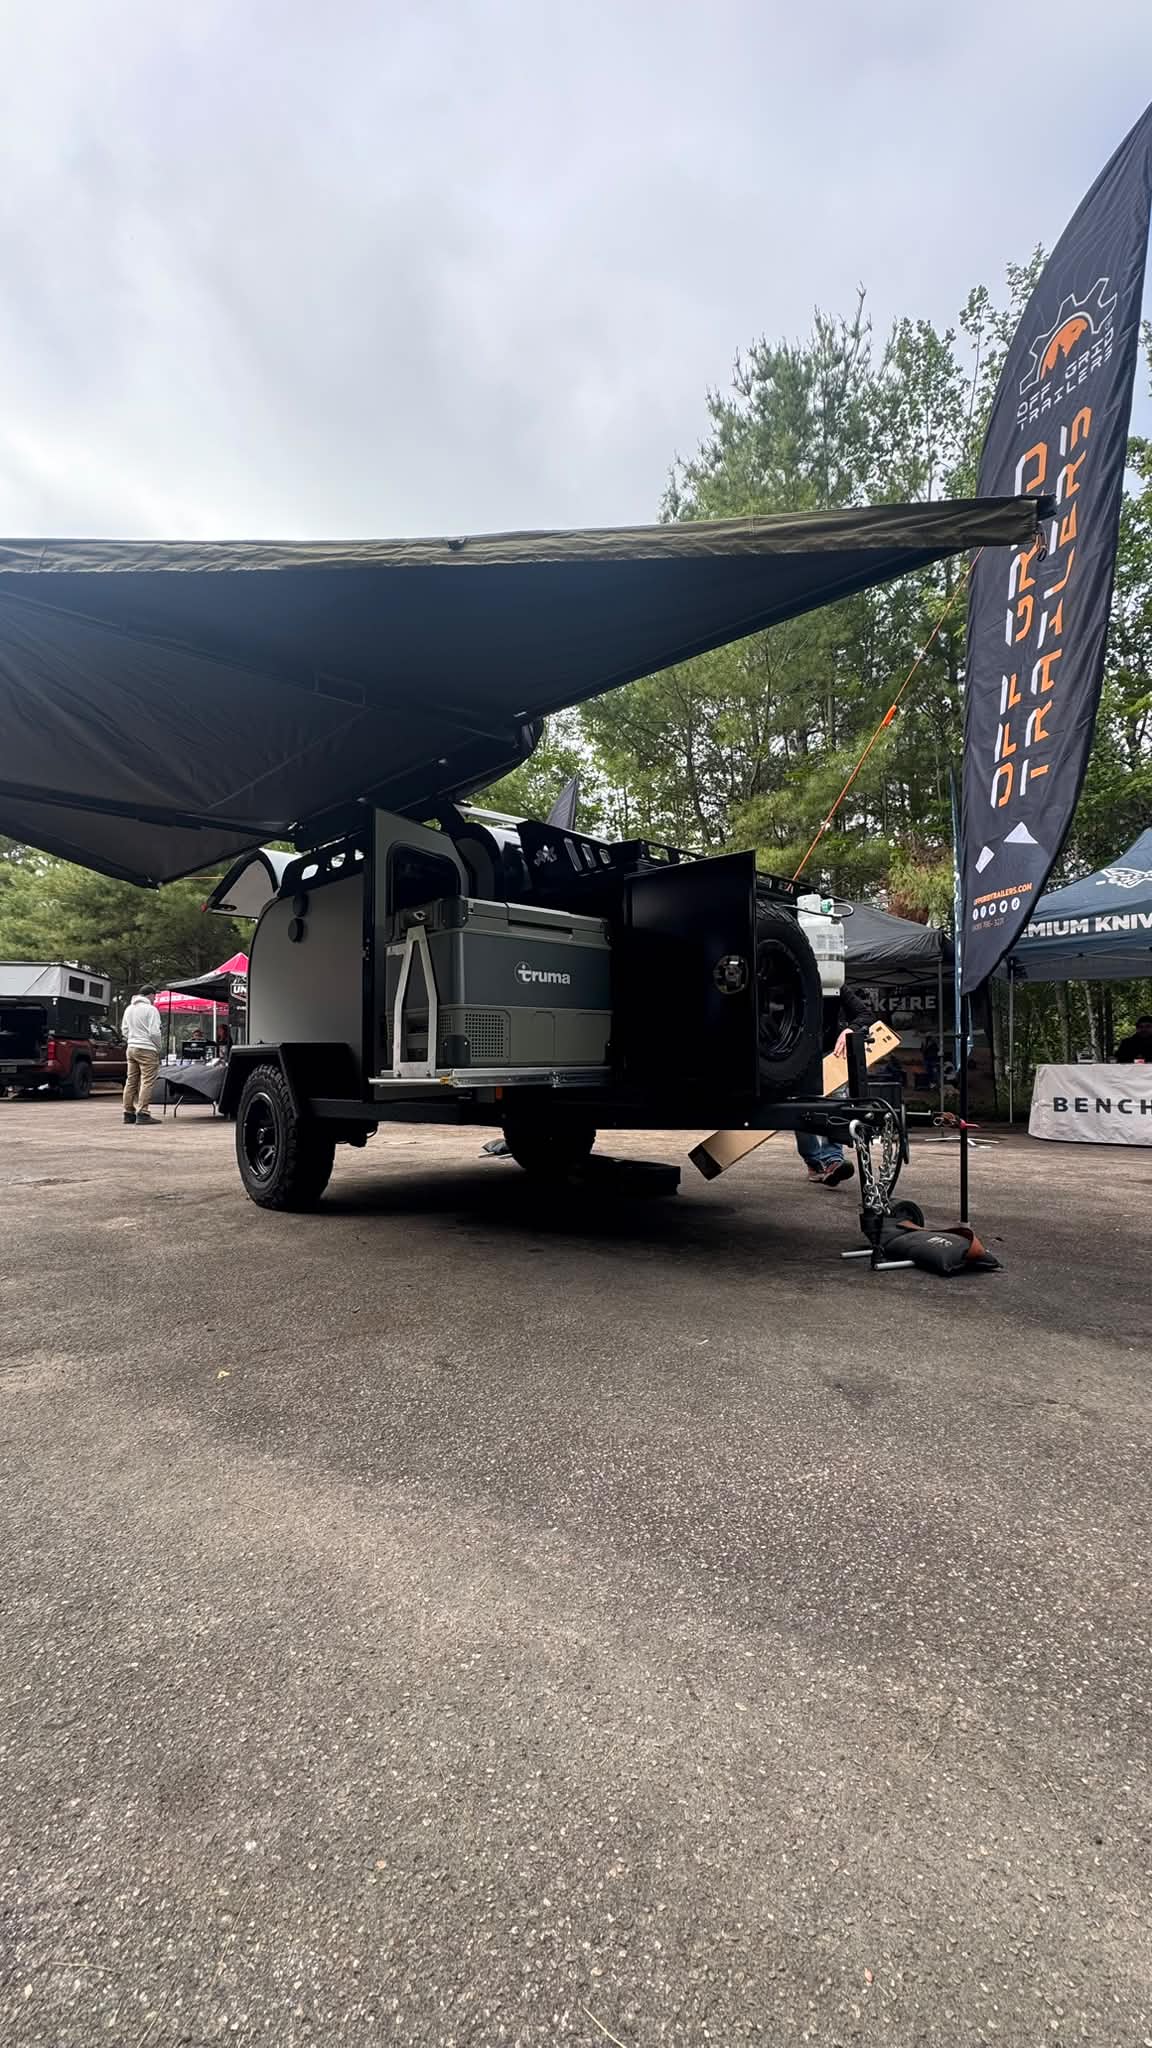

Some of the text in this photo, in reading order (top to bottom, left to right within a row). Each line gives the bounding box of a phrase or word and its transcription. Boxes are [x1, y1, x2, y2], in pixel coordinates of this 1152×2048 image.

[1017, 327, 1114, 417] OFF GRID
[1017, 343, 1113, 431] TRAILERS
[990, 442, 1048, 808] OFF GRD
[1020, 406, 1092, 796] TRAILERS
[517, 964, 571, 984] truma
[1053, 1097, 1152, 1115] BENCH
